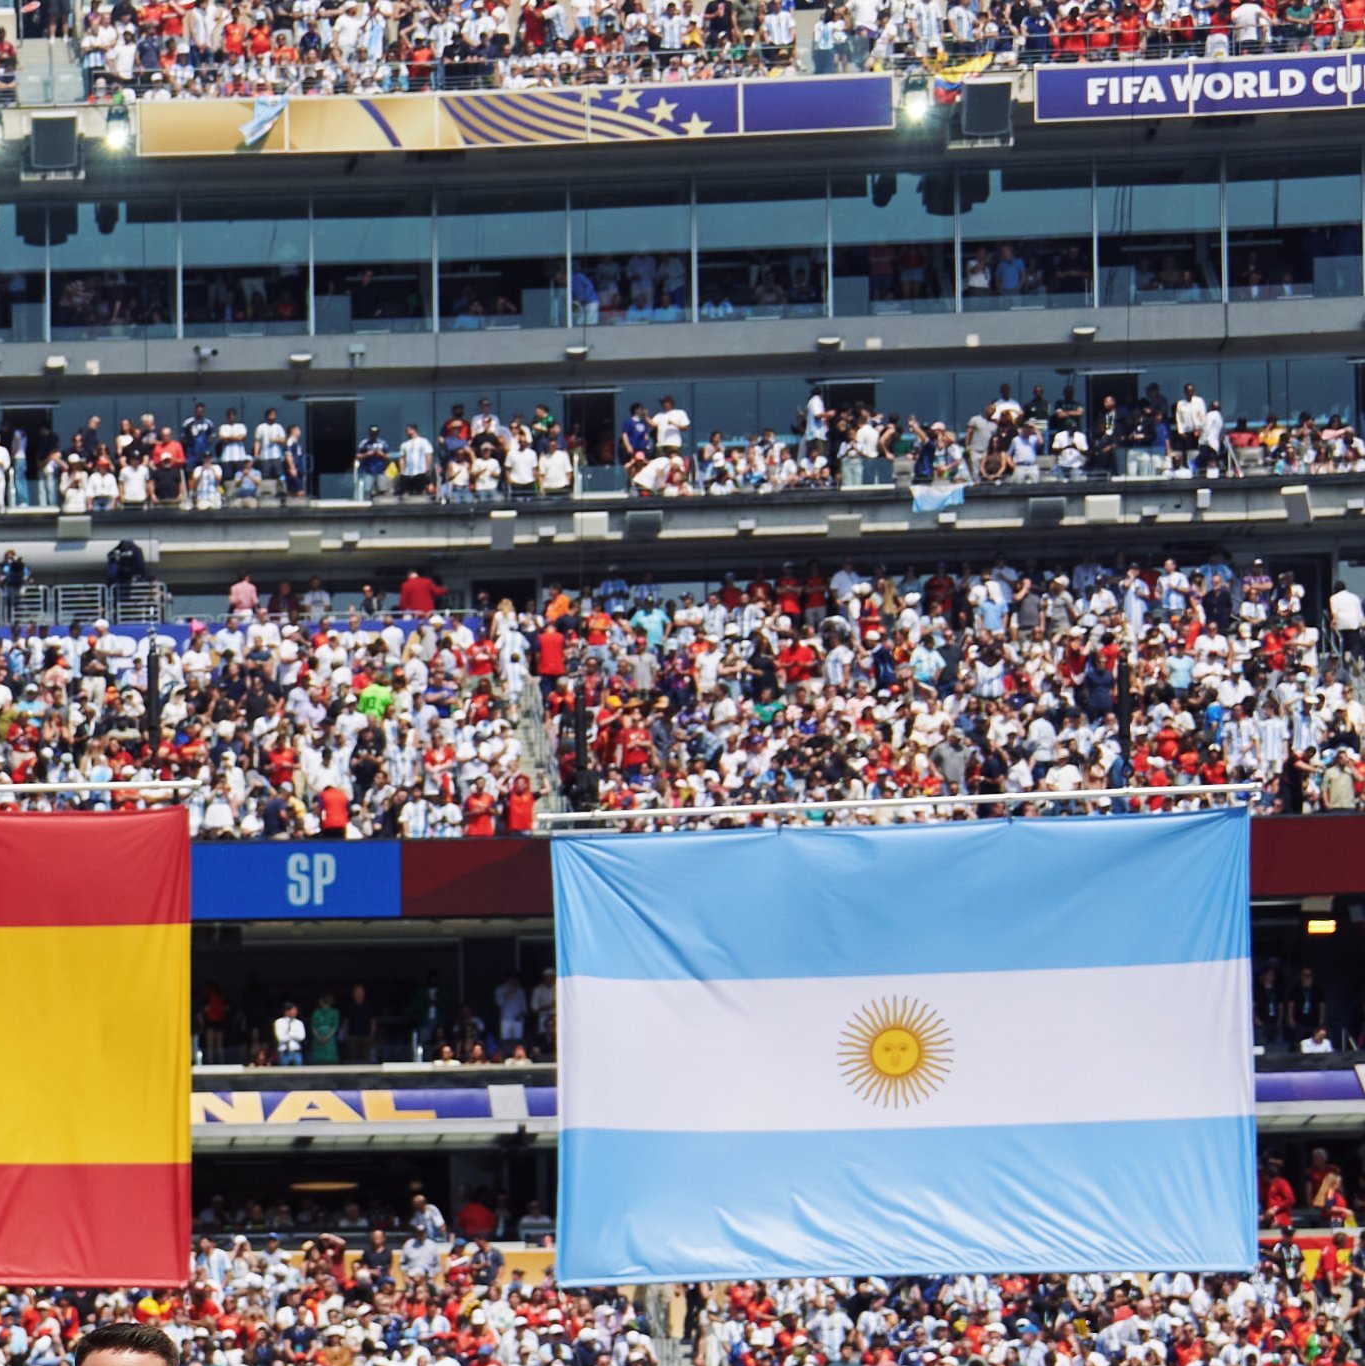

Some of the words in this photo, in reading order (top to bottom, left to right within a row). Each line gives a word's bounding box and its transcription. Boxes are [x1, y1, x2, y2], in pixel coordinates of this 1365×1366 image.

[1087, 75, 1166, 106] FIFA
[1170, 69, 1306, 102] WORLD
[287, 853, 336, 906] SP
